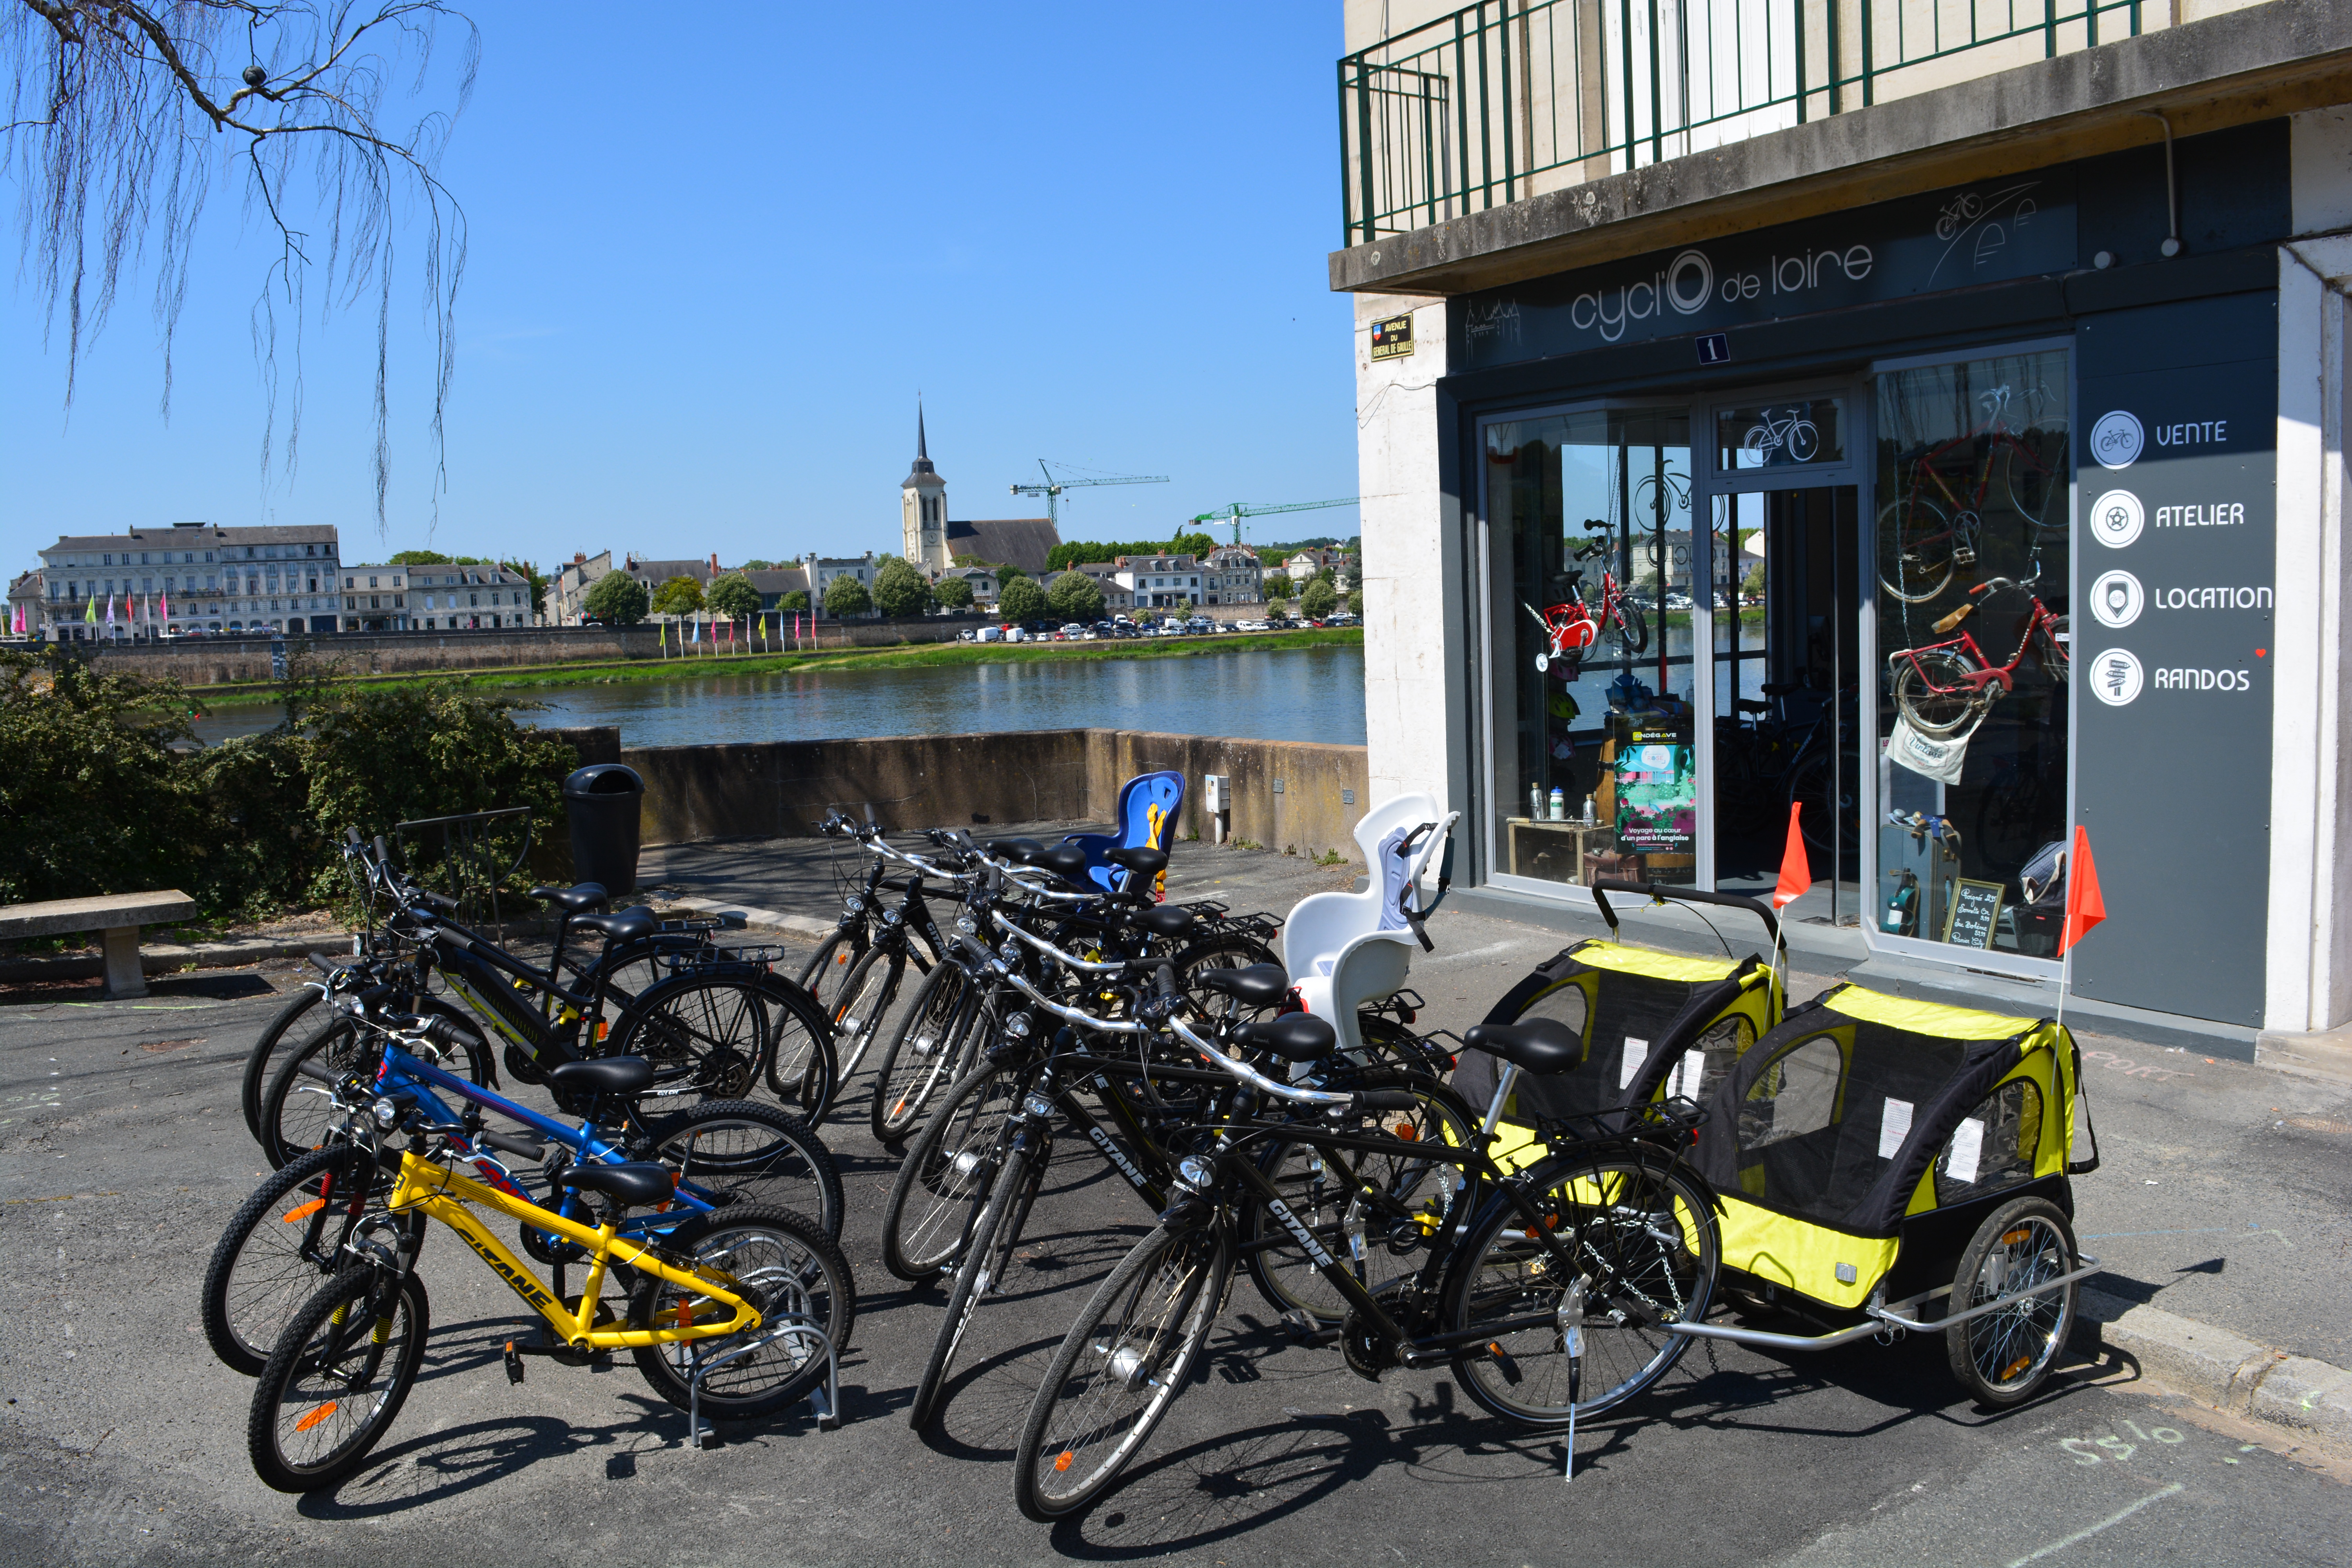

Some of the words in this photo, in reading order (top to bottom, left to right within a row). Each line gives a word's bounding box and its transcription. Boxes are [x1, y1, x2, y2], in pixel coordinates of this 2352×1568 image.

[1722, 273, 1760, 302] de
[1772, 245, 1873, 295] loire
[1385, 320, 1407, 332] AVENUE
[1373, 345, 1390, 357] GENERAL
[1391, 343, 1396, 354] DE
[1397, 340, 1412, 353] GAULLE
[1708, 338, 1718, 360] 1
[2156, 421, 2227, 446] VENTE
[2156, 503, 2244, 527] ATELIER
[2156, 587, 2273, 609] LOCATION
[2155, 668, 2249, 691] RANDOS
[1957, 904, 1979, 914] Sonnette
[1954, 918, 1964, 927] Sac
[926, 922, 948, 959] GITAN
[1951, 932, 1970, 944] Panier
[1971, 937, 1985, 949] City
[1089, 1127, 1147, 1187] GITANE
[1269, 1199, 1334, 1267] GITANE
